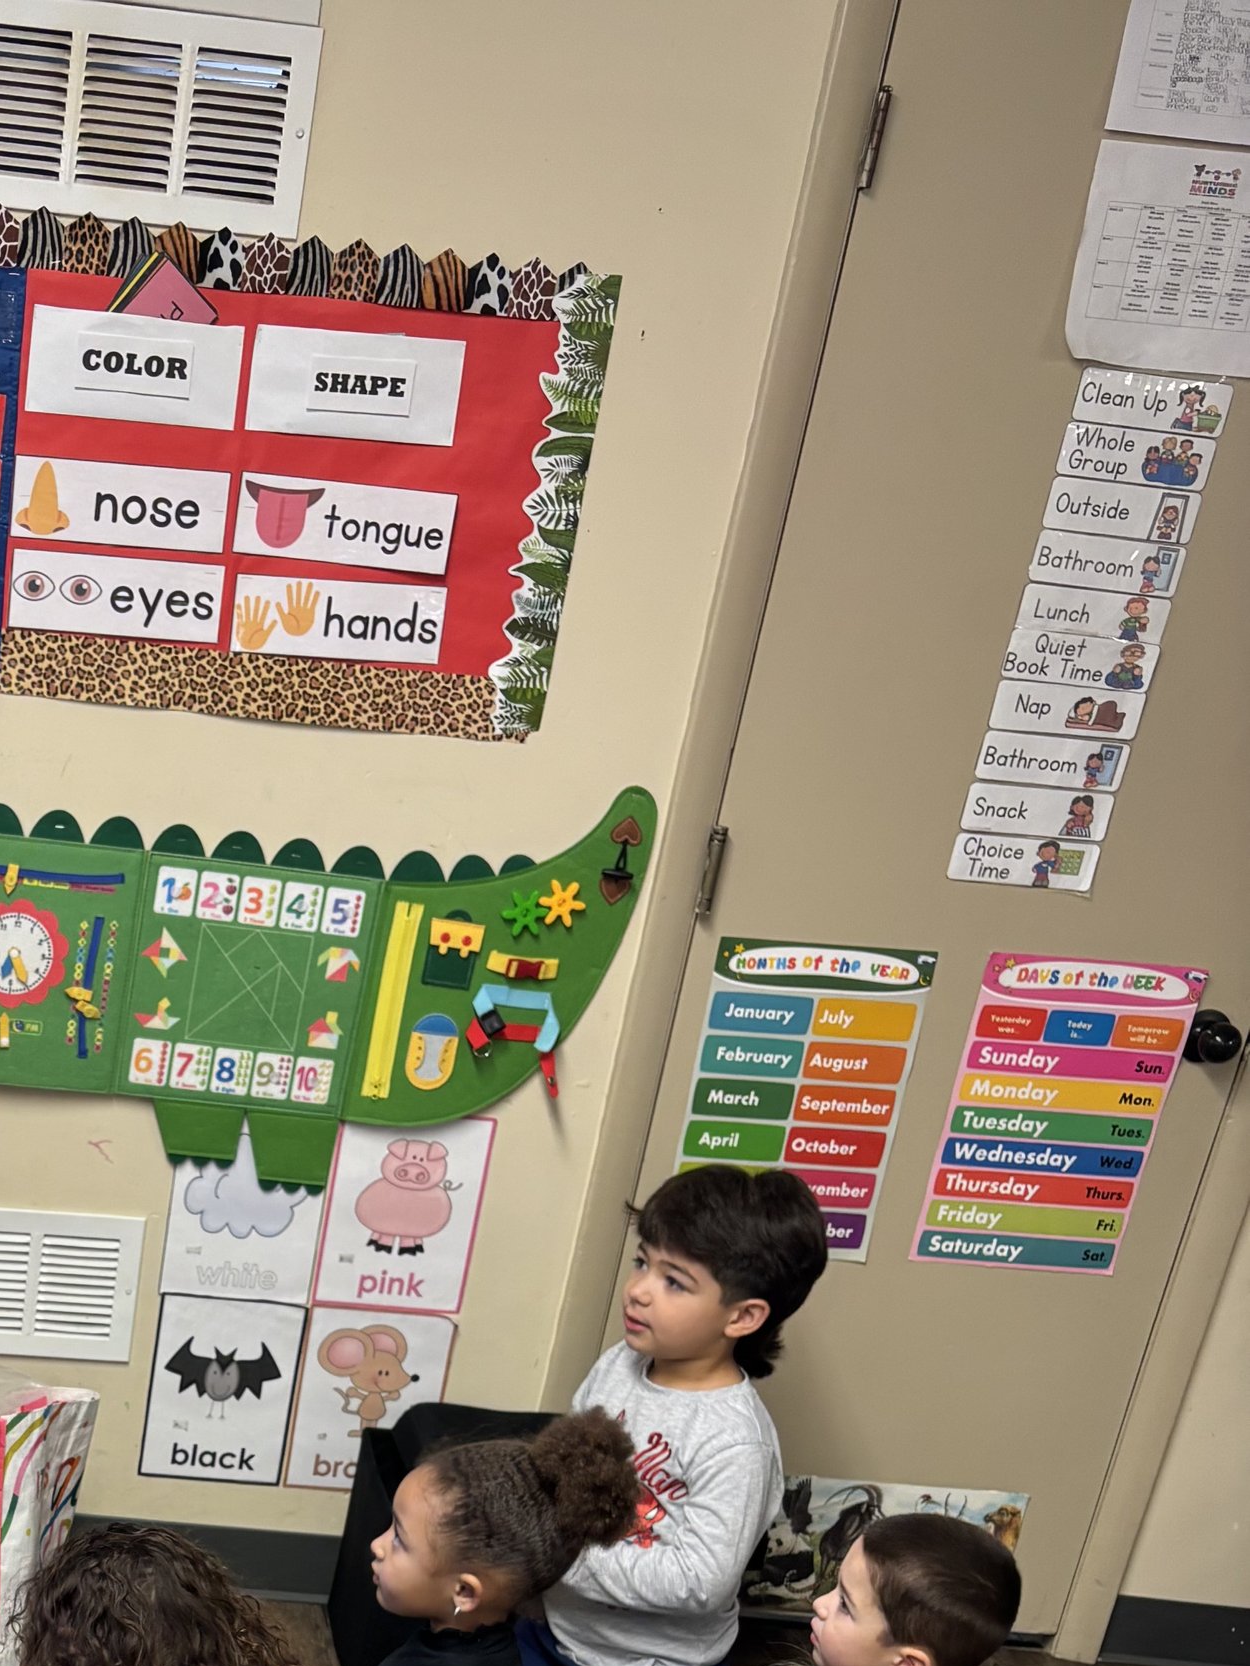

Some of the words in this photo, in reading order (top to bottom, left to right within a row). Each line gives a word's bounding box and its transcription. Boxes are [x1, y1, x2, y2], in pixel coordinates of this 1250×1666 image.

[1190, 186, 1236, 197] MINDS
[82, 348, 188, 381] COLOR
[314, 371, 407, 399] SHAPE
[1081, 382, 1135, 410] Clean
[1143, 386, 1168, 415] Up
[1075, 426, 1136, 453] Whole
[1068, 450, 1128, 480] Group
[1055, 493, 1131, 521] Outside
[93, 490, 200, 530] nose
[325, 504, 444, 555] tongue
[1037, 546, 1134, 579] Bathroom
[110, 585, 213, 628] eyes
[324, 597, 438, 644] hands
[1034, 598, 1090, 624] Lunch
[1034, 634, 1087, 659] Quiet
[1002, 652, 1050, 677] Book
[1059, 657, 1103, 683] Time
[1014, 693, 1052, 720] Nap
[982, 746, 1078, 775] Bathroom
[972, 796, 1029, 821] Snack
[963, 837, 1024, 861] Choice
[968, 858, 1010, 881] Time
[162, 878, 175, 903] 1
[200, 882, 220, 908] 2
[244, 887, 263, 914] 3
[286, 894, 307, 919] 4
[331, 898, 350, 925] 5
[736, 957, 797, 971] MONTHS
[830, 957, 861, 974] the
[870, 963, 910, 981] YEAR
[1017, 968, 1059, 984] DAYS
[1063, 969, 1084, 985] of
[1089, 970, 1118, 988] the
[1123, 975, 1165, 992] WEEK
[725, 1004, 795, 1024] January
[819, 1009, 854, 1029] July
[990, 1014, 1031, 1026] Yesterday
[1067, 1020, 1093, 1032] Today
[1127, 1024, 1170, 1037] Tomorrow
[134, 1048, 153, 1073] 6
[177, 1052, 194, 1077] 7
[216, 1057, 236, 1082] 8
[256, 1062, 274, 1087] 9
[296, 1066, 317, 1092] 10
[716, 1047, 793, 1068] February
[809, 1053, 869, 1074] August
[979, 1046, 1060, 1073] Sunday
[707, 1090, 759, 1107] March
[800, 1096, 890, 1117] September
[970, 1079, 1058, 1105] Monday
[962, 1111, 1049, 1138] Tuesday
[699, 1132, 739, 1148] April
[791, 1138, 857, 1156] October
[954, 1142, 1077, 1172] Wednesday
[808, 1182, 869, 1199] vember
[945, 1174, 1040, 1201] Thursday
[937, 1205, 1002, 1229] Friday
[929, 1235, 1023, 1262] Saturday
[196, 1261, 278, 1290] white
[356, 1270, 424, 1298] pink
[170, 1442, 256, 1471] black
[312, 1454, 356, 1477] bro
